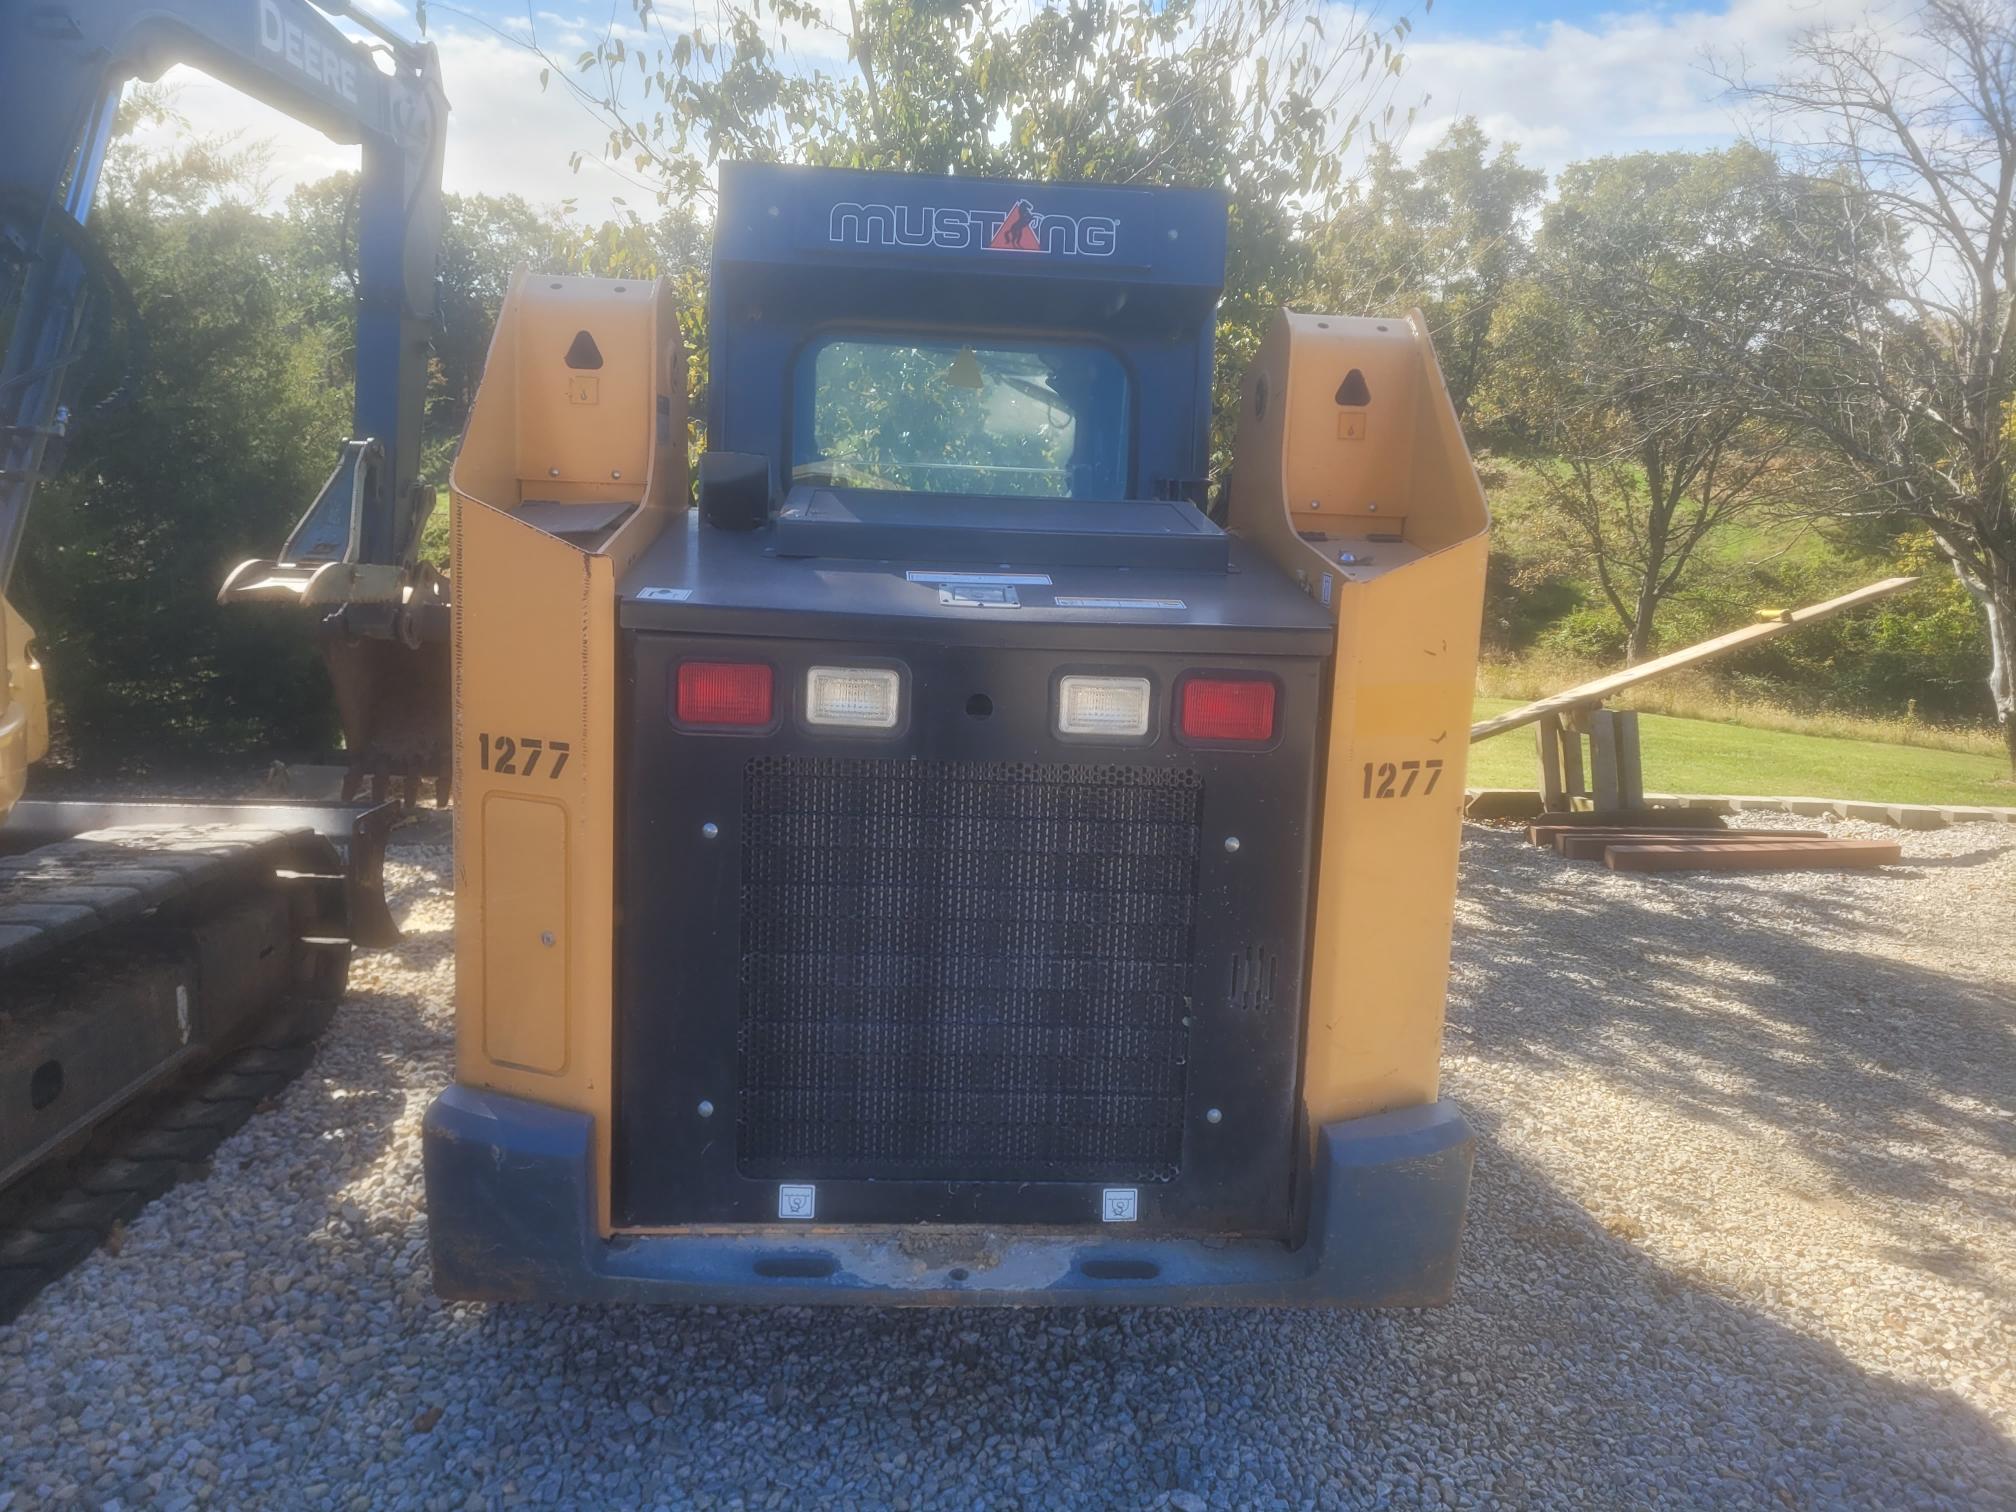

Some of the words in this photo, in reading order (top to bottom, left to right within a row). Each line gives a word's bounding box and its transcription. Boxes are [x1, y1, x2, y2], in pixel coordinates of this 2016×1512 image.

[260, 0, 358, 103] DEERE
[479, 733, 570, 779] 1277
[1363, 760, 1443, 799] 1277
